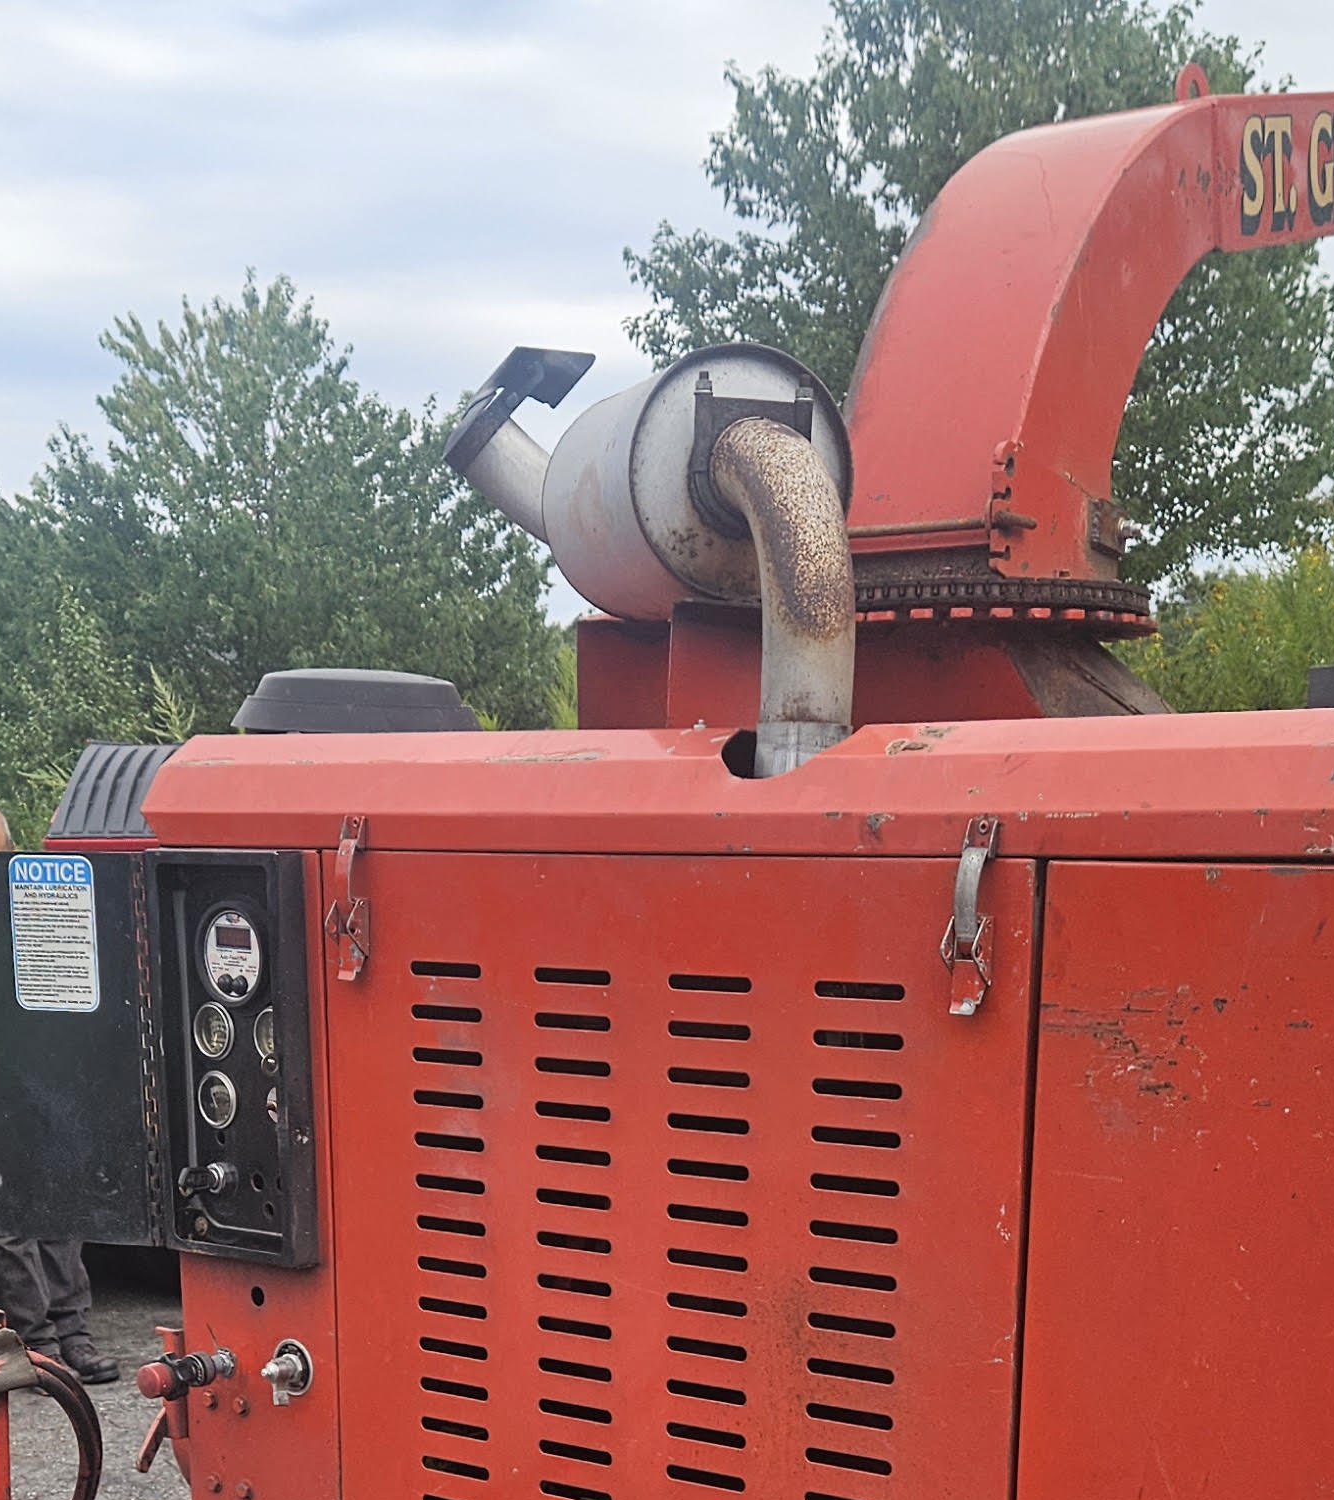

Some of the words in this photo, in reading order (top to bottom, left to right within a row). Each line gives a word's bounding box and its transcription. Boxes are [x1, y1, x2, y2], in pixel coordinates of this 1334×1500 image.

[1240, 114, 1298, 233] ST.
[14, 861, 86, 882] NOTICE
[14, 883, 43, 891] MAINTAIN
[44, 884, 87, 892] LUBRICATION
